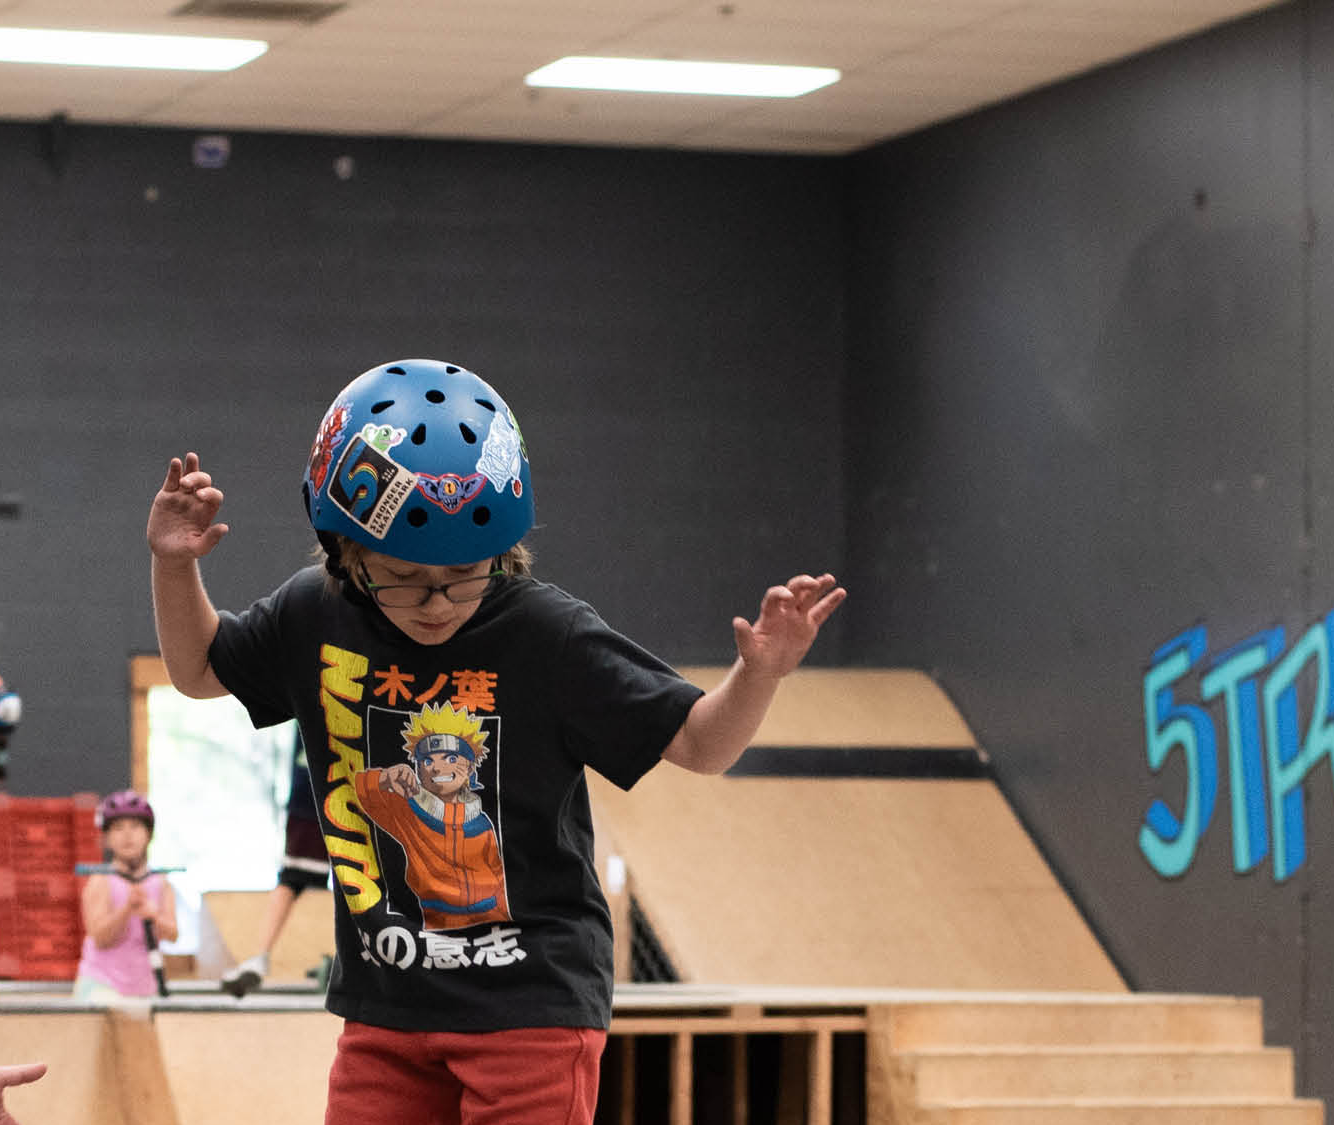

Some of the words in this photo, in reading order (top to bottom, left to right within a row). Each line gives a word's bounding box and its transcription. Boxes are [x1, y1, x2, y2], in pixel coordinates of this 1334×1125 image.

[339, 438, 379, 520] 5
[370, 480, 403, 532] STRONGER
[375, 478, 414, 536] SKATEPARK
[373, 664, 498, 713] 木ノ葉
[319, 643, 383, 915] NARUTO
